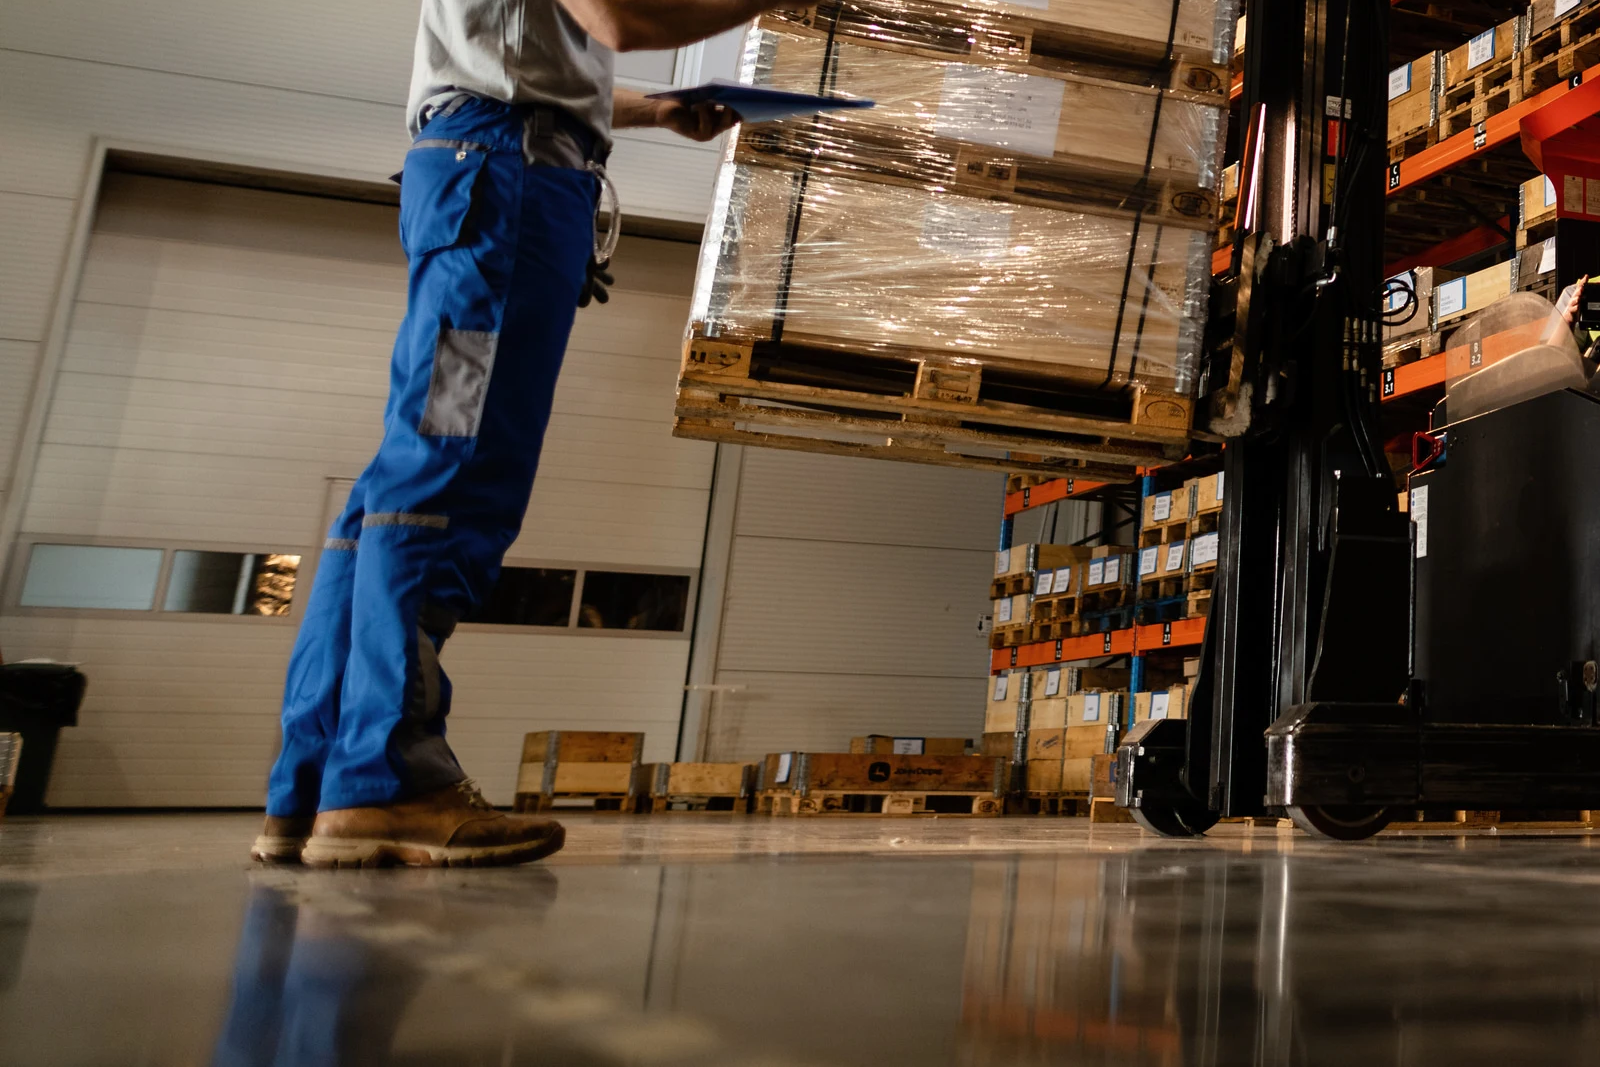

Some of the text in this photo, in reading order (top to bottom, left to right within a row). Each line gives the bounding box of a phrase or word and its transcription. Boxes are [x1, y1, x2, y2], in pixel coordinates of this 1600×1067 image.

[1574, 77, 1578, 86] C
[1478, 124, 1482, 133] C
[1393, 166, 1397, 174] C
[1391, 176, 1399, 186] 3.1
[1474, 342, 1478, 353] B
[1472, 354, 1481, 365] 3.2
[1387, 372, 1391, 382] B
[1385, 383, 1393, 393] 3.1
